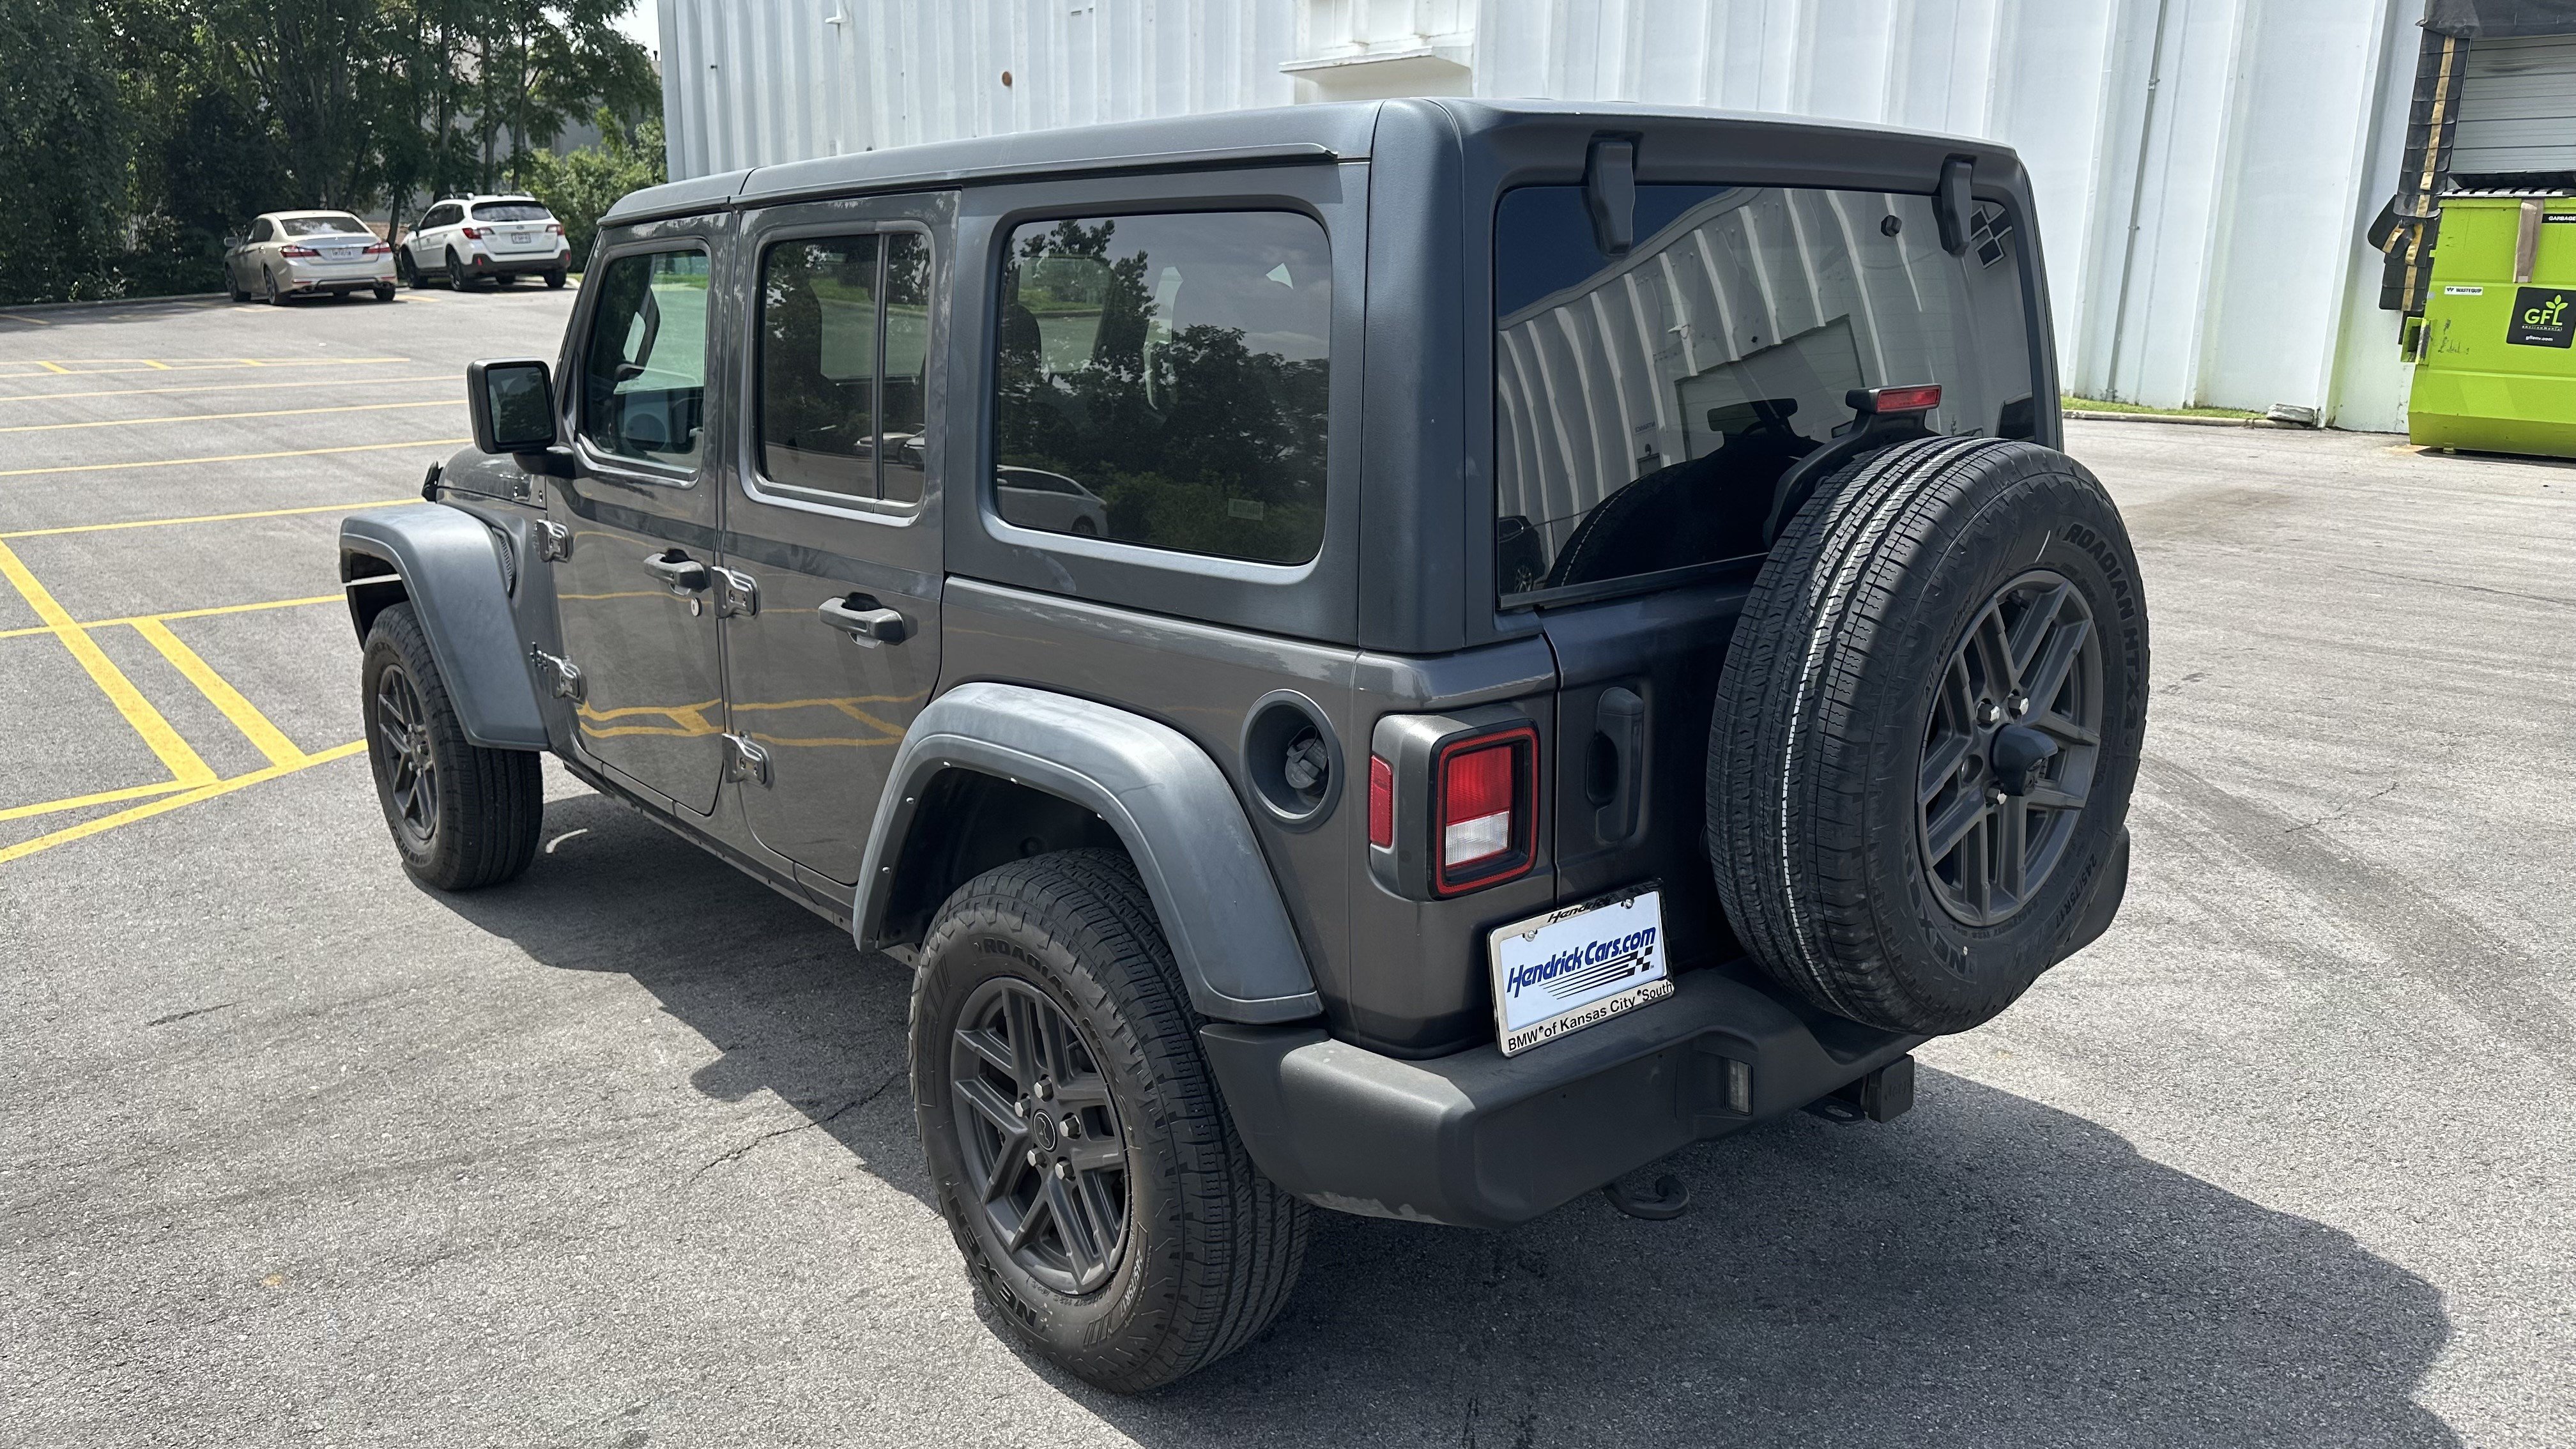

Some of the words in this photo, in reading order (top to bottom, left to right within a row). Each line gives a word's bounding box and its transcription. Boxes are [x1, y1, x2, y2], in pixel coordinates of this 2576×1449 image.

[2524, 303, 2568, 326] GFL
[2062, 523, 2135, 621] ROADIAN
[1508, 1029, 1538, 1051] BMW
[1544, 1022, 1557, 1038] of
[1560, 1008, 1607, 1032] Kansas
[1610, 995, 1636, 1013] City
[1641, 981, 1673, 1002] South
